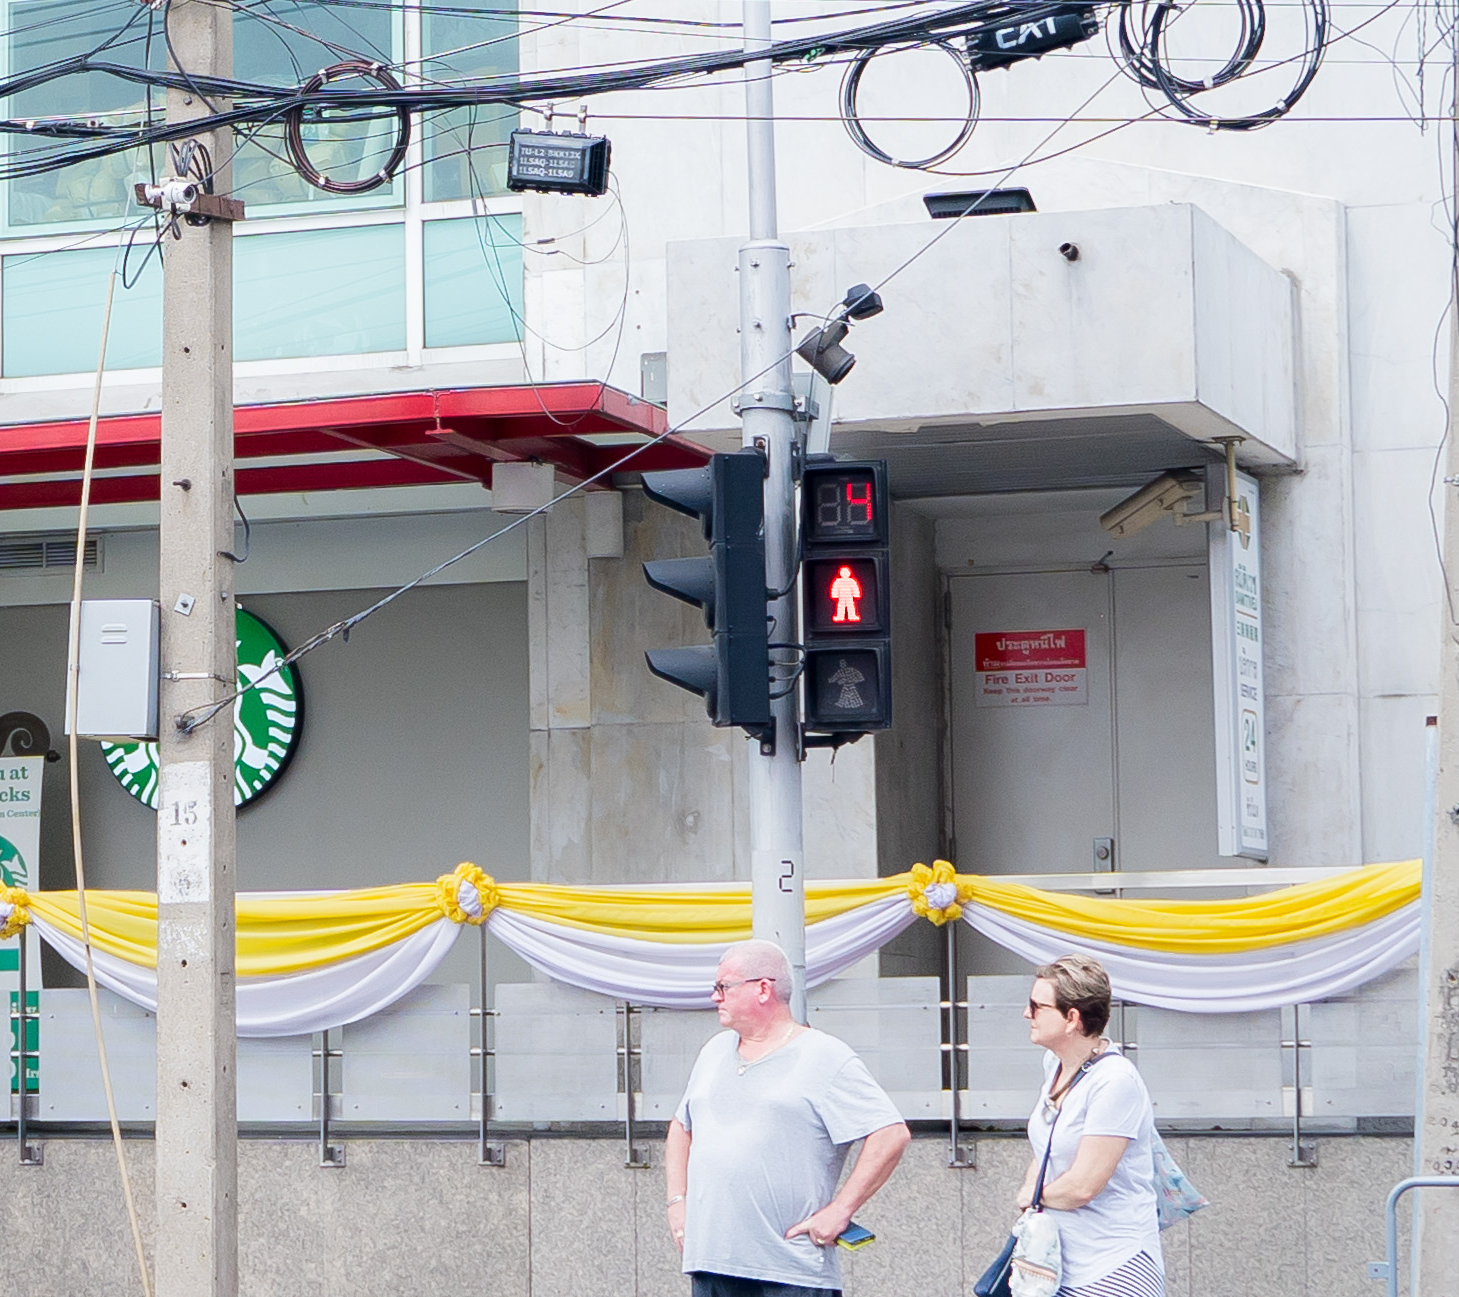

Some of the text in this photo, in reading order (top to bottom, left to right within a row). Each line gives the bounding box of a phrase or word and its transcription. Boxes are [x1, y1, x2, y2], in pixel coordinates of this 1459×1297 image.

[995, 16, 1057, 49] CAT
[846, 482, 873, 521] 4
[996, 633, 1067, 655] ประตูหนีไฟ
[985, 672, 1077, 685] Fire Exit Door
[1243, 718, 1257, 754] 24
[9, 766, 29, 780] at
[170, 800, 198, 826] 15
[778, 859, 794, 893] 2
